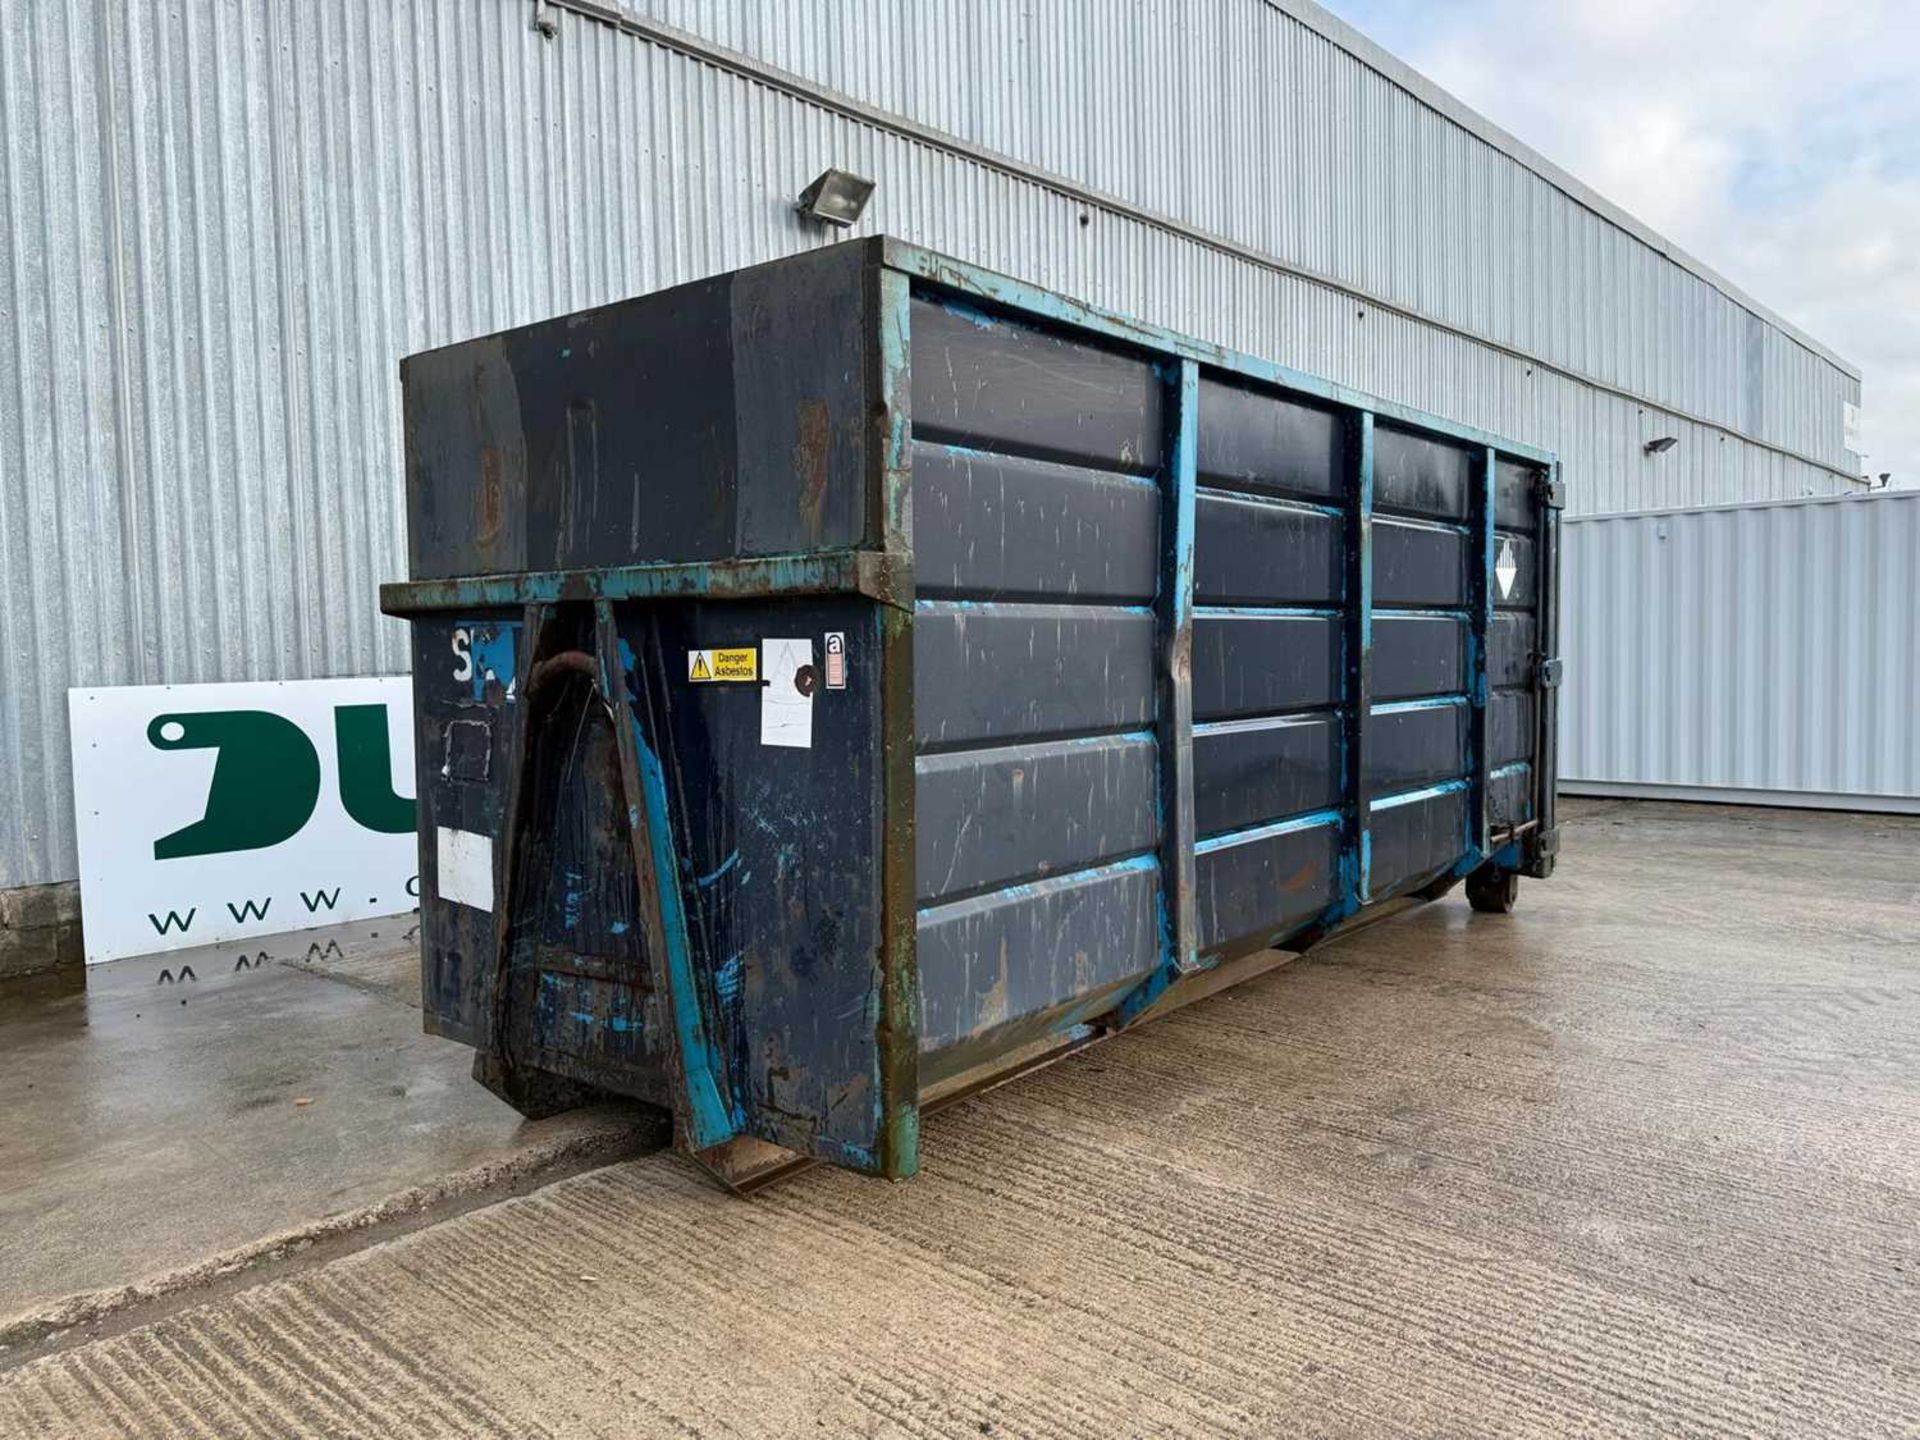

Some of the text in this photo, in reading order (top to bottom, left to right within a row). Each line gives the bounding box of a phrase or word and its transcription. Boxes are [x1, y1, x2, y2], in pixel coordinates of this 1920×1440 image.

[828, 635, 841, 654] a
[718, 652, 748, 664] Danger
[714, 665, 753, 677] Asbestos
